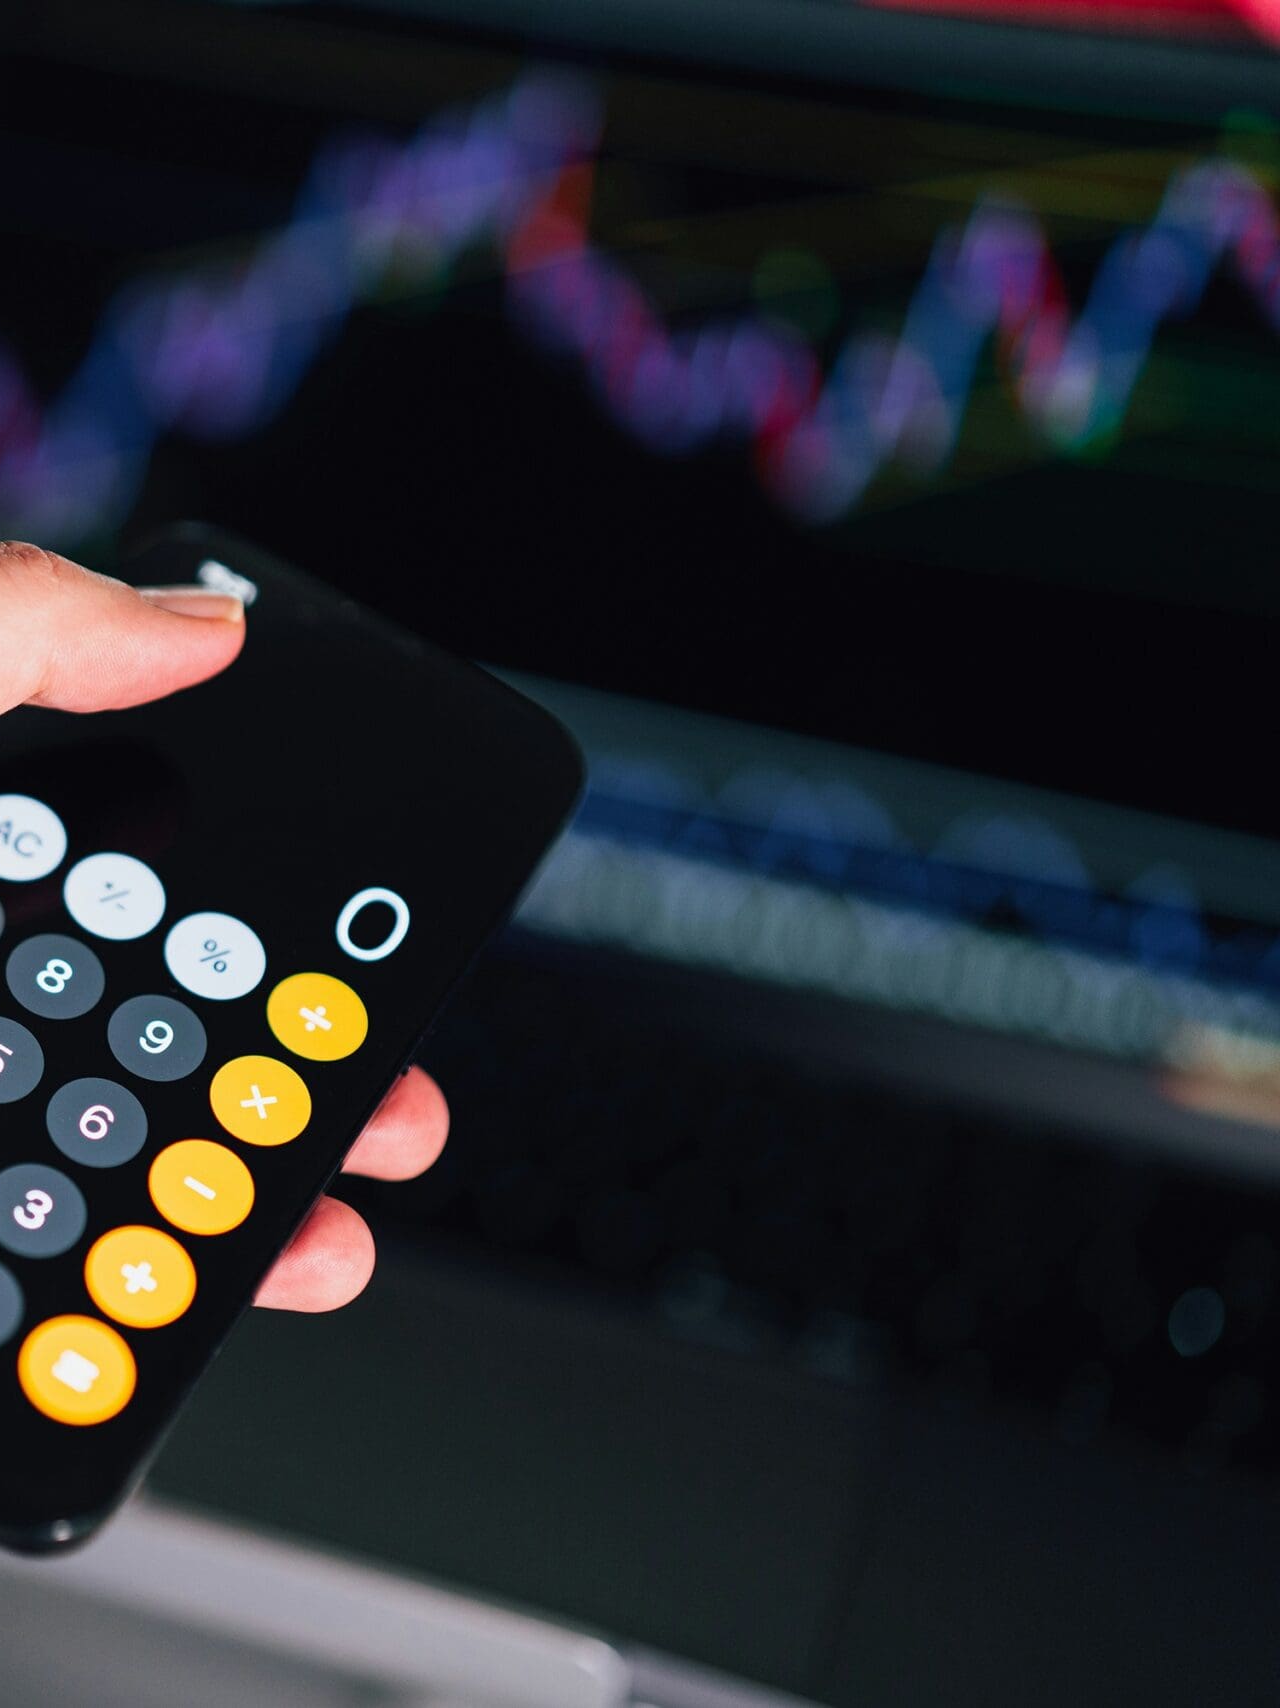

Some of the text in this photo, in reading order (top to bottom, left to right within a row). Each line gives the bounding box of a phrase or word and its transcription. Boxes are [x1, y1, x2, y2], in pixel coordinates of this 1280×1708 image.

[337, 888, 409, 960] 0
[200, 940, 229, 973] %
[37, 959, 72, 993] 8
[140, 1021, 173, 1053] 9
[80, 1105, 114, 1139] 6
[14, 1190, 53, 1229] 3
